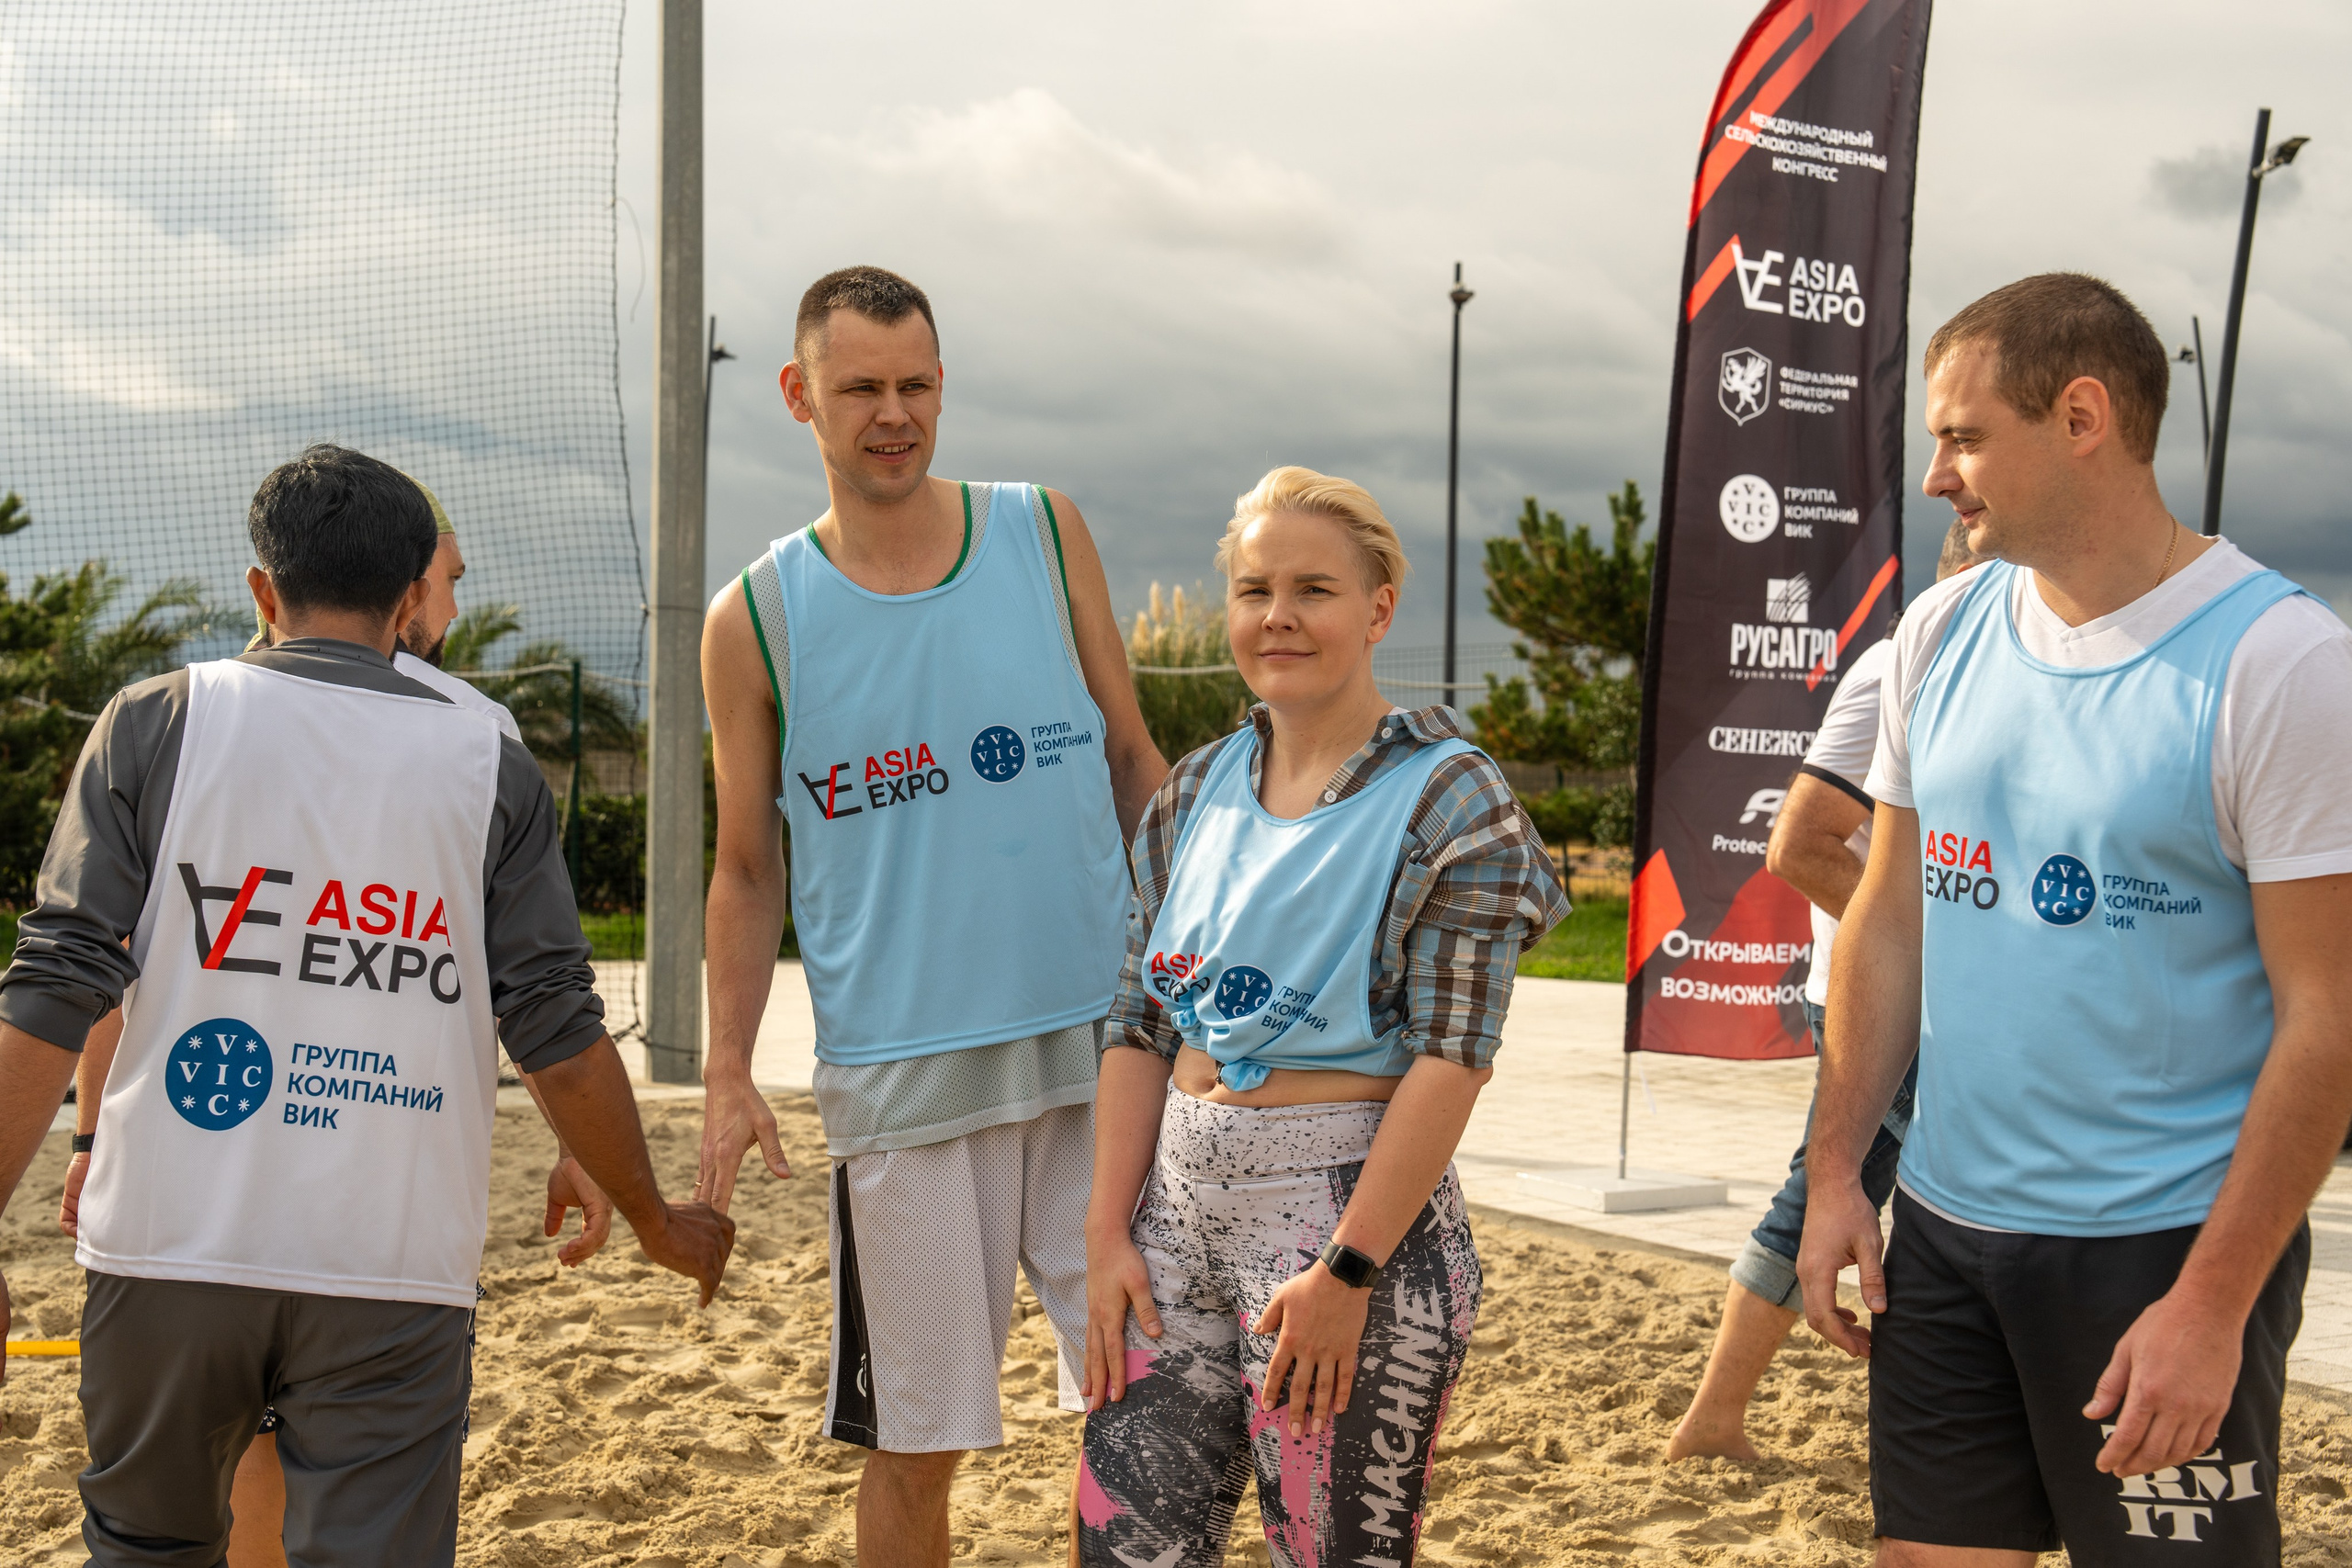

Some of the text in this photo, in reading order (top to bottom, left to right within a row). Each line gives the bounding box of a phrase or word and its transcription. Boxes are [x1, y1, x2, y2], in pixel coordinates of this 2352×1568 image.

[1749, 110, 1873, 148] МЕЖДУНАРОДНЫЙ
[1772, 156, 1838, 182] КОНГРЕСС
[1789, 256, 1860, 295] ASIA
[1789, 288, 1866, 327] EXPO
[1779, 381, 1849, 401] ТЕРРИТОРИЯ
[1780, 366, 1858, 388] ФЕДЕРАЛЬНАЯ
[1783, 487, 1838, 503] ГРУППА
[1784, 504, 1859, 525] КОМПАНИЙ
[1784, 523, 1814, 538] ВИК
[1730, 623, 1838, 671] РУСАГРО
[1034, 730, 1092, 752] КОМПАНИЙ
[865, 742, 937, 783] ASIA
[1036, 753, 1063, 768] ВИК
[866, 768, 950, 809] EXPO
[1926, 829, 1993, 874] ASIA
[1926, 863, 2000, 910] EXPO
[2103, 874, 2170, 896] ГРУППА
[306, 879, 452, 948] ASIA
[2103, 893, 2202, 915] КОМПАНИЙ
[2105, 912, 2136, 930] ВИК
[299, 932, 461, 1004] EXPO
[1277, 986, 1317, 1005] ГРУП
[291, 1043, 398, 1077] ГРУППА
[287, 1072, 444, 1112] КОМПАНИЙ
[283, 1102, 340, 1130] ВИК
[1359, 1277, 1446, 1539] MACHINE
[2119, 1501, 2213, 1542] IT
